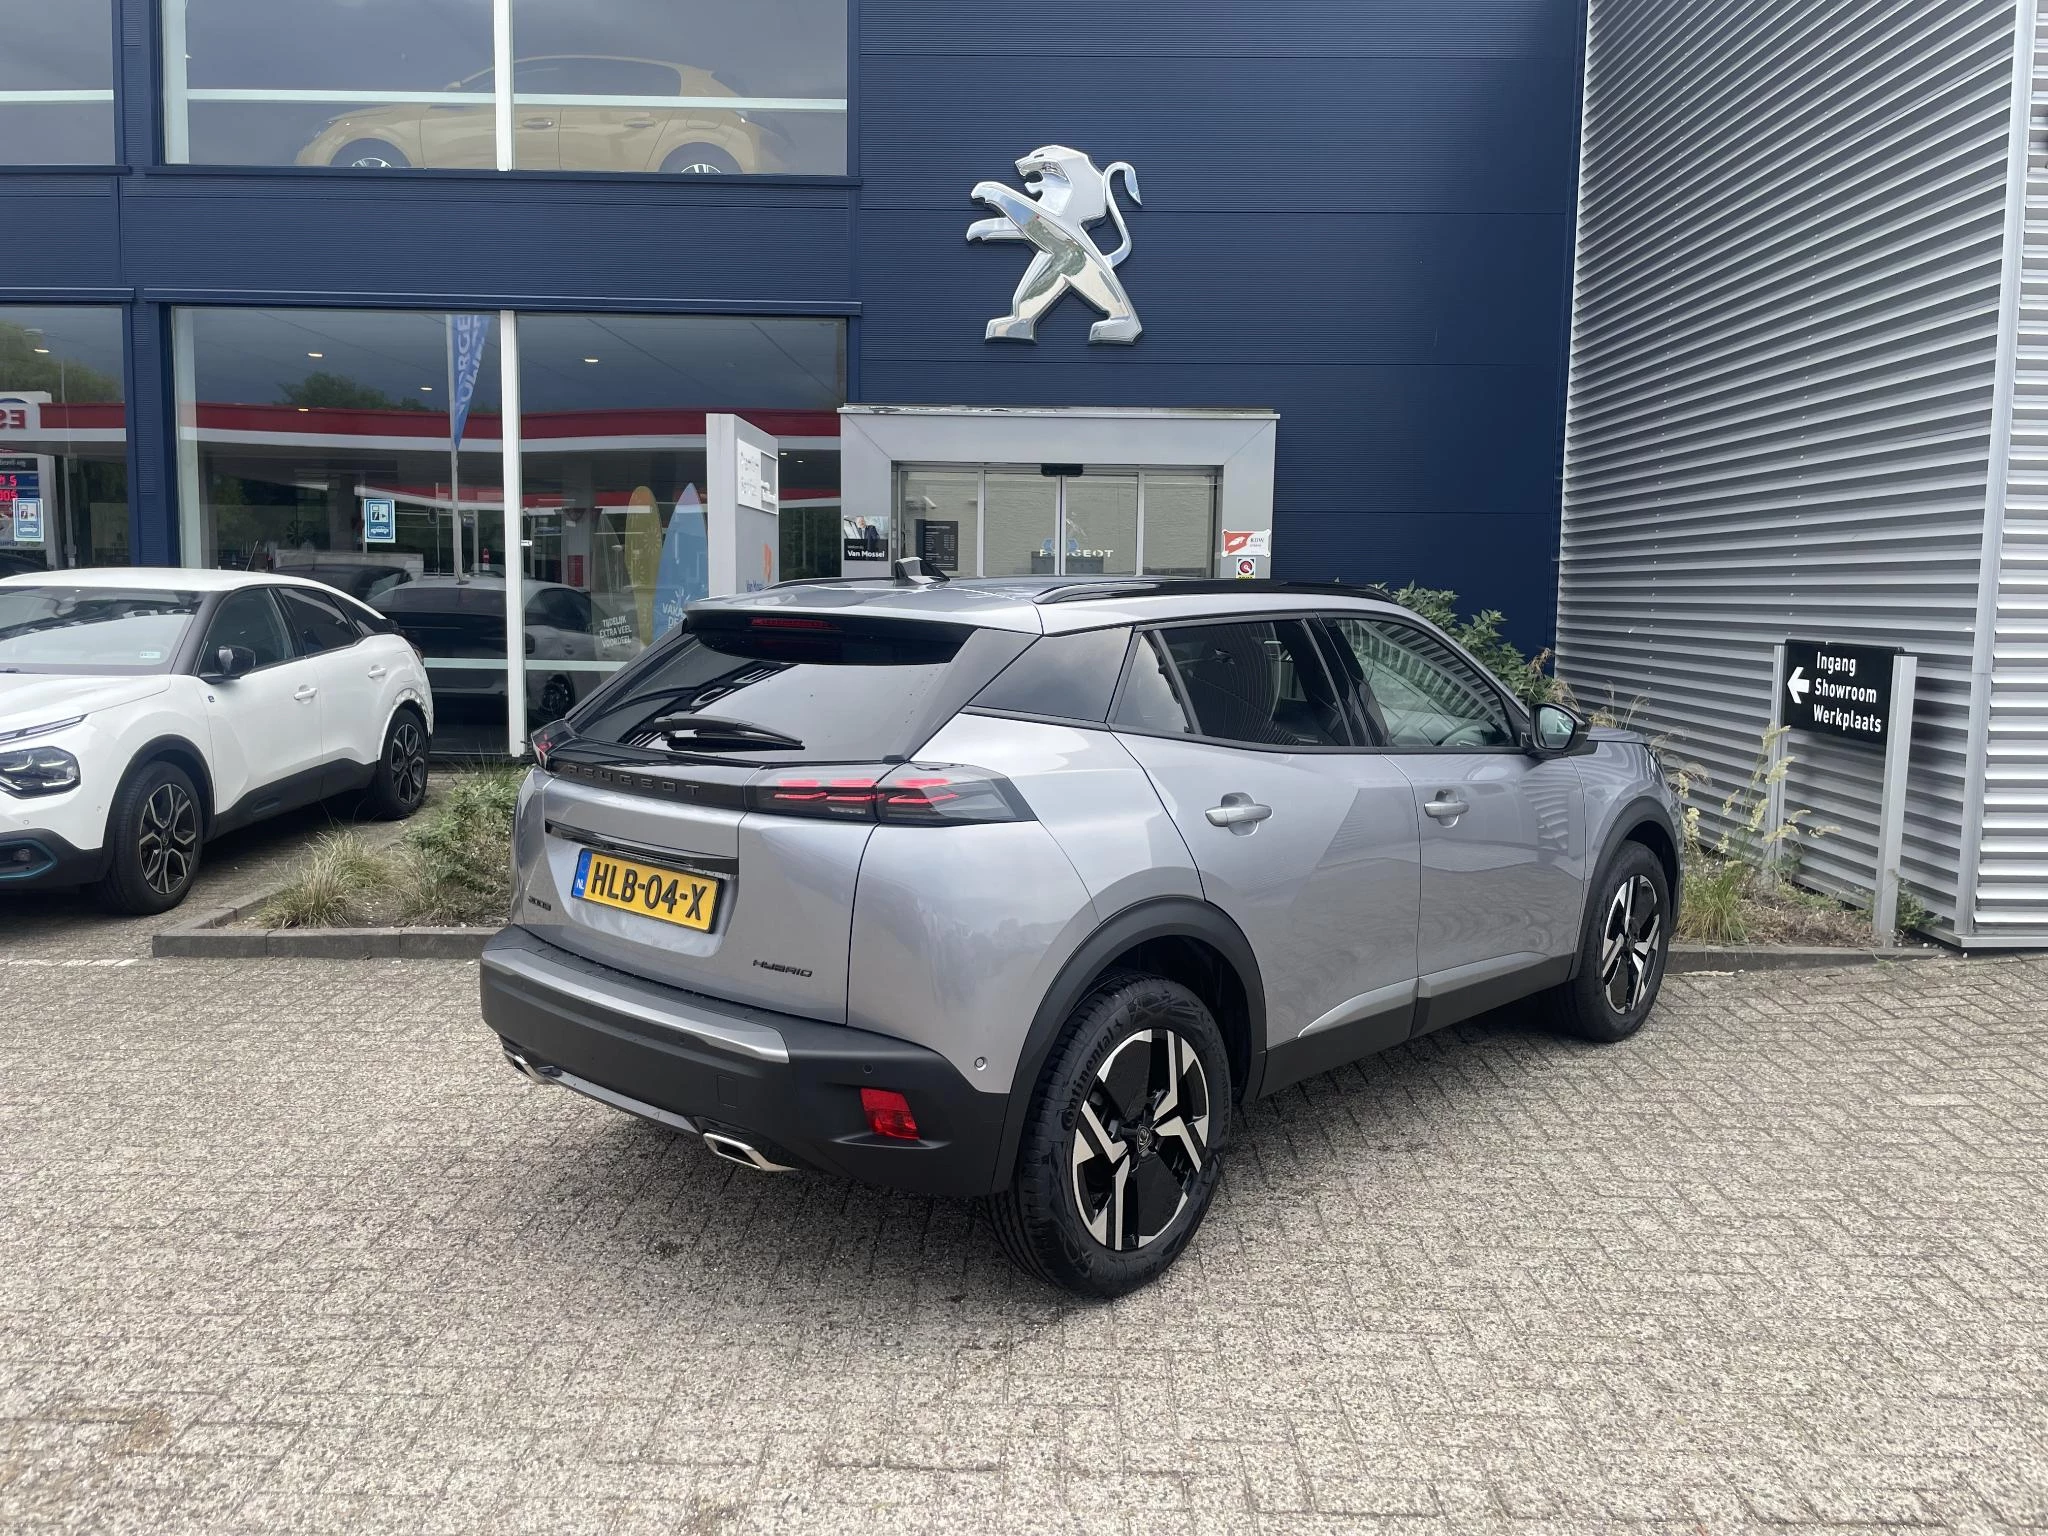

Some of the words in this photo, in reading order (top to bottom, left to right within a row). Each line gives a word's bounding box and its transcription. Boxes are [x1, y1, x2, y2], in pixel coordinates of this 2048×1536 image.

[861, 550, 885, 558] Mossel
[599, 627, 618, 639] EXTRA
[618, 625, 633, 635] VEEL
[602, 635, 632, 648] VOORDEEL
[1816, 651, 1857, 677] Ingang
[1814, 677, 1877, 703] Showroom
[1813, 703, 1882, 733] Werkplaats
[567, 763, 700, 797] PEUGEOT
[575, 878, 585, 890] NL
[590, 861, 708, 921] HLB-04-X
[752, 959, 813, 977] HYBRID
